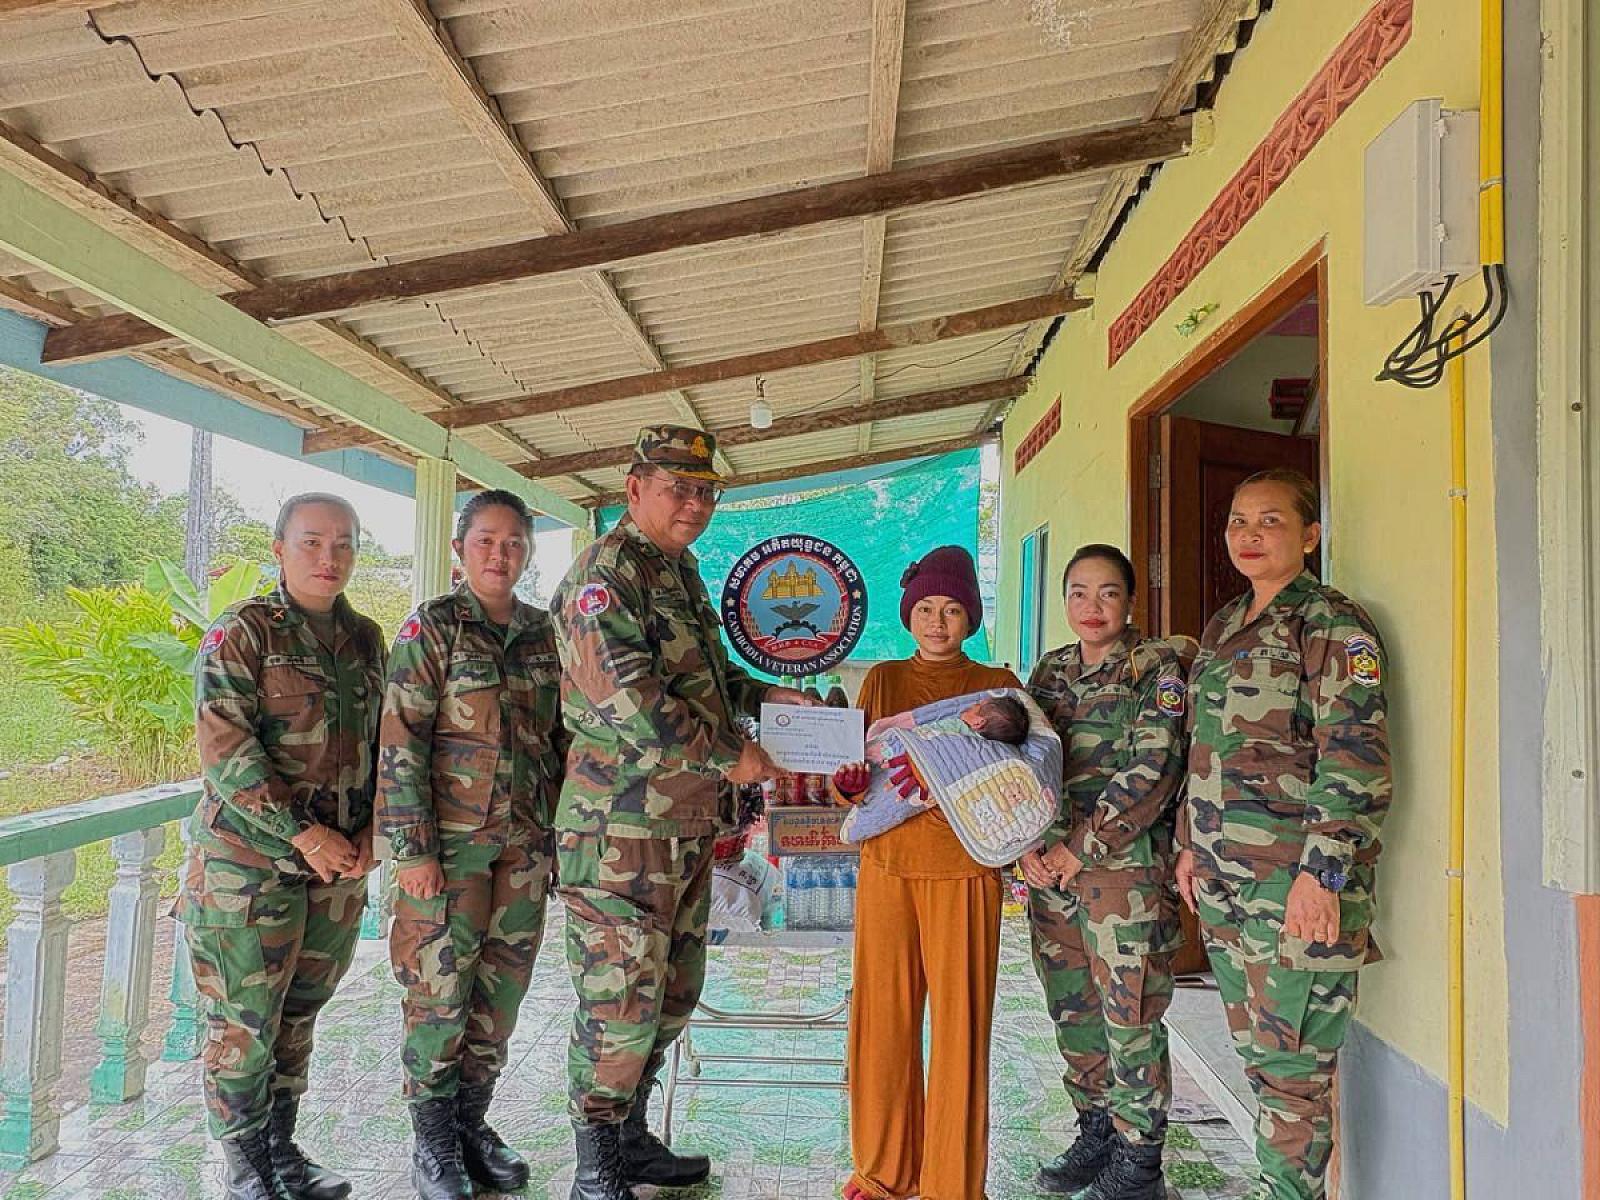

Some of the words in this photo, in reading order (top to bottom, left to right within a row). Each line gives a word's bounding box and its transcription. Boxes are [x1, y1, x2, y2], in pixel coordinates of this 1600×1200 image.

[728, 550, 761, 589] សមាគម
[727, 611, 763, 665] CAMBODIA
[764, 659, 818, 674] VETERAN
[819, 605, 863, 669] ASSOCIATION
